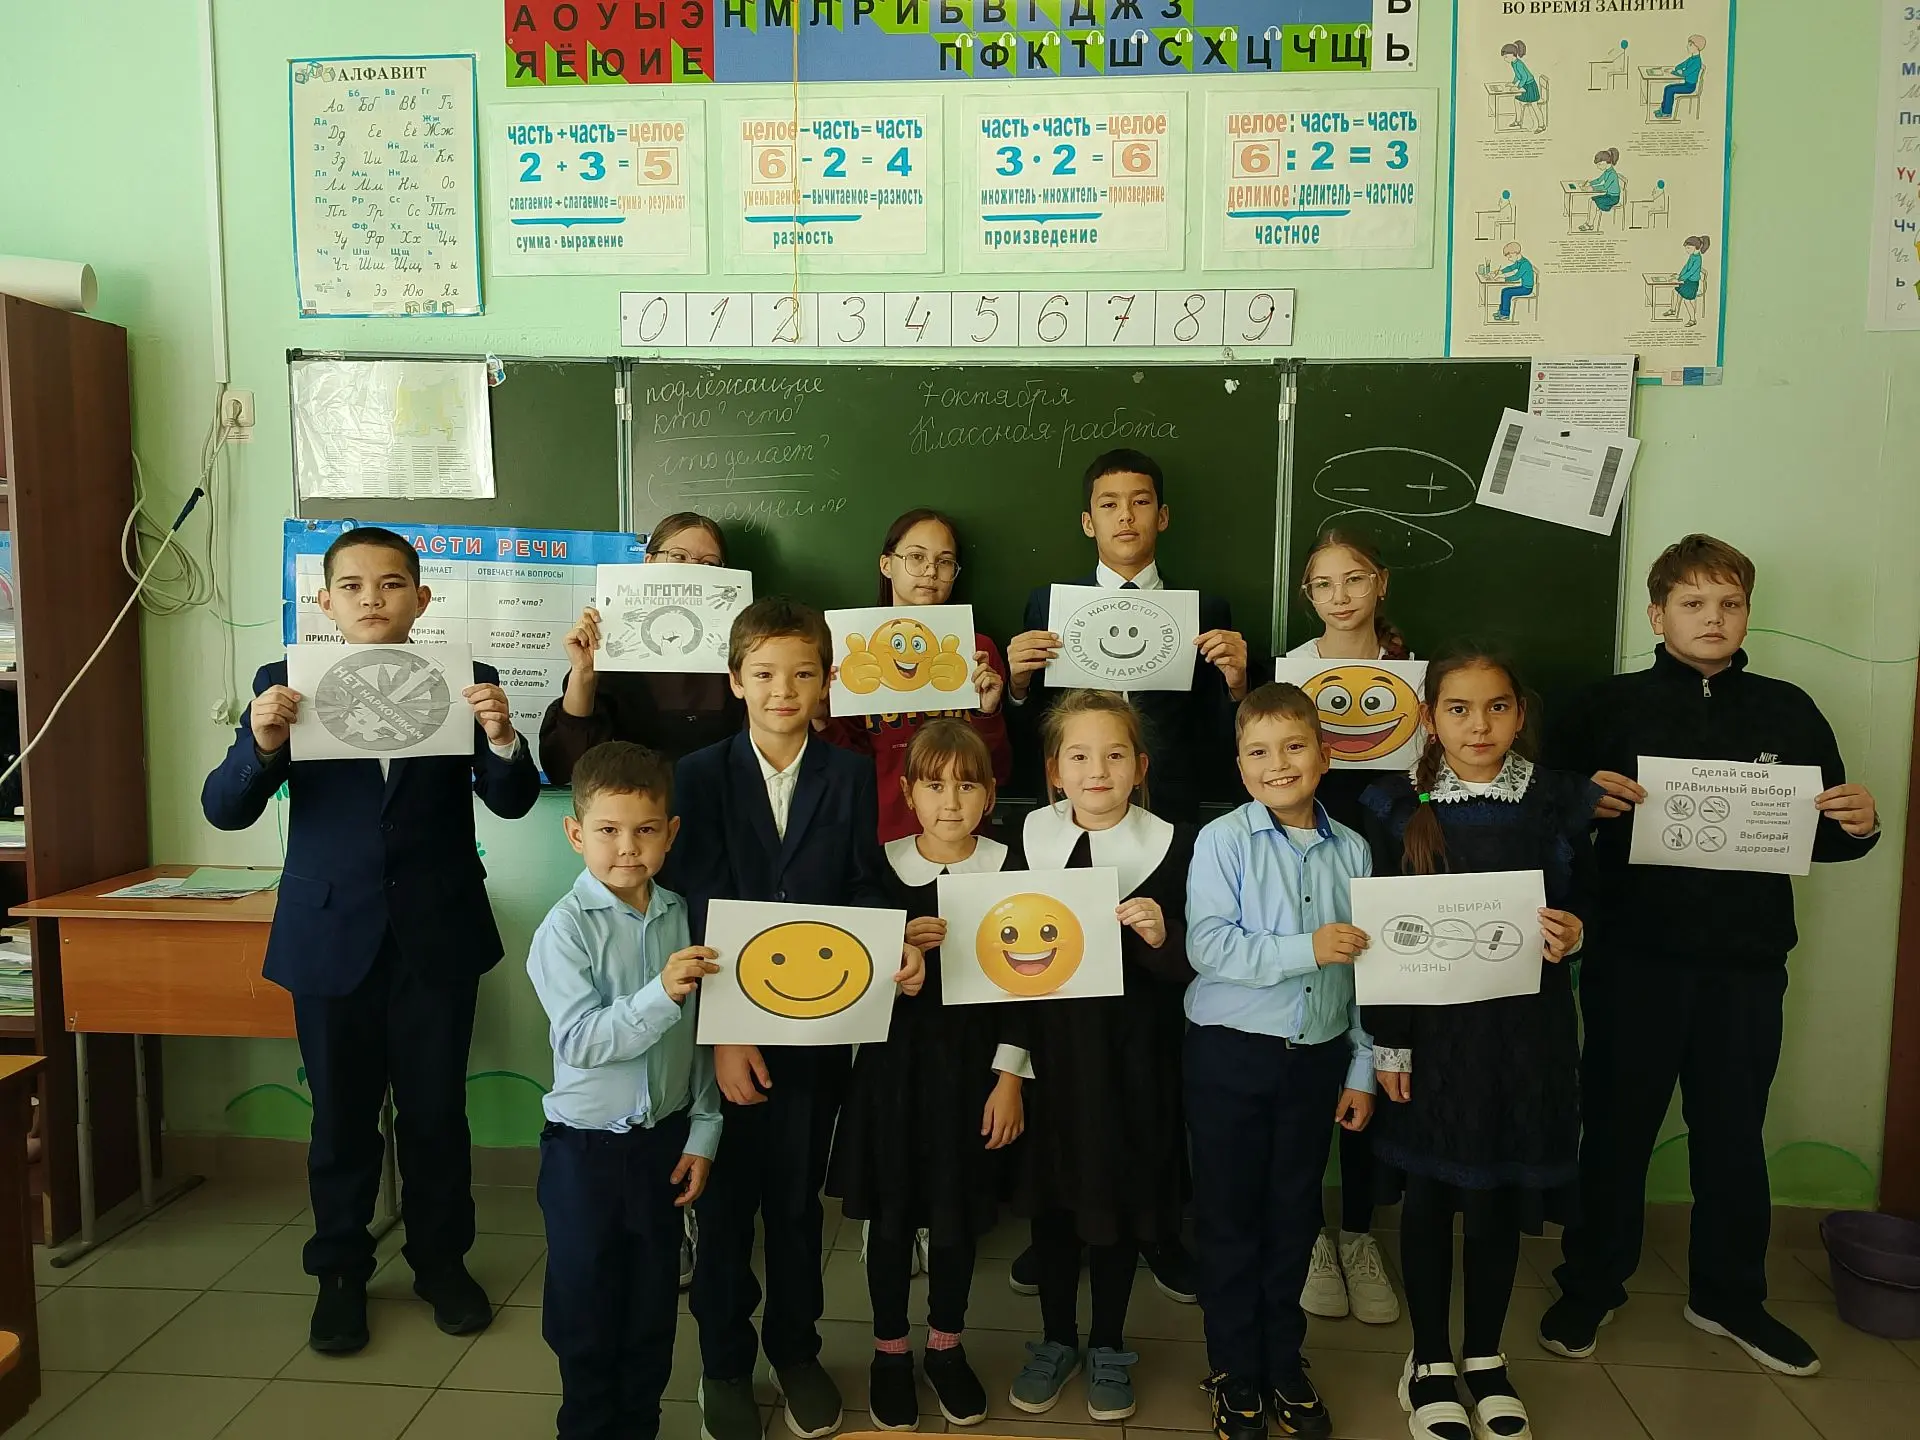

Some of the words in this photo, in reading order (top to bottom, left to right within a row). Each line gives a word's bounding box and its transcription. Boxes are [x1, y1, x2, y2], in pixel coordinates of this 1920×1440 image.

[512, 5, 537, 32] А
[553, 4, 579, 31] О
[597, 3, 619, 30] У
[634, 2, 666, 29] Ы
[681, 1, 704, 28] Э
[724, 0, 747, 27] Н
[1502, 2, 1525, 14] ВО
[1530, 0, 1591, 13] ВРЕМЯ
[514, 51, 537, 78] Я
[556, 43, 577, 77] Ё
[592, 49, 625, 77] Ю
[640, 48, 661, 76] И
[683, 47, 703, 75] Е
[940, 43, 962, 71] П
[980, 41, 1009, 70] Ф
[1027, 41, 1048, 69] К
[1110, 38, 1143, 67] Ш
[1159, 37, 1182, 66] С
[1203, 36, 1227, 65] Х
[1247, 35, 1272, 69] Ц
[1293, 34, 1316, 62] Ч
[1331, 33, 1367, 68] Щ
[1386, 33, 1411, 62] Ь
[338, 67, 427, 81] АЛФАВИТ
[507, 125, 553, 145] часть
[569, 124, 616, 144] часть
[629, 123, 685, 147] целое
[813, 121, 860, 140] часть
[876, 119, 923, 139] часть
[982, 118, 1029, 138] часть
[1043, 117, 1090, 137] часть
[1108, 115, 1167, 140] целое
[1228, 114, 1287, 138] целое
[1300, 112, 1350, 133] часть
[1368, 111, 1418, 132] часть
[519, 152, 542, 182] 2
[579, 151, 606, 181] 3
[643, 151, 673, 180] 5
[758, 149, 786, 178] 6
[823, 147, 846, 177] 2
[886, 147, 912, 177] 4
[995, 146, 1023, 177] 3
[1052, 144, 1076, 175] 2
[1121, 143, 1152, 172] 6
[1240, 144, 1270, 173] 6
[1310, 141, 1334, 170] 2
[1385, 140, 1409, 170] 3
[812, 188, 869, 205] вычитаемое
[877, 189, 923, 210] разность
[981, 188, 1036, 205] множитель
[1042, 186, 1097, 203] множитель
[1227, 184, 1290, 211] делимое
[1299, 184, 1351, 211] делитель
[1366, 183, 1414, 204] частное
[516, 236, 551, 252] сумма
[561, 234, 624, 252] выражение
[773, 231, 834, 249] разность
[984, 228, 1098, 249] произведение
[1255, 225, 1320, 244] частное
[639, 297, 668, 342] 0
[708, 297, 730, 342] 1
[771, 297, 799, 343] 2
[837, 296, 866, 342] 3
[905, 296, 931, 342] 4
[971, 296, 999, 342] 5
[1037, 295, 1069, 342] 6
[1108, 294, 1136, 342] 7
[1173, 294, 1206, 342] 8
[1241, 294, 1275, 341] 9
[919, 381, 939, 407] 7
[941, 379, 1075, 427] октября
[909, 415, 1053, 455] Классная
[1057, 407, 1180, 469] работа
[406, 535, 482, 555] АСТИ
[497, 538, 568, 559] РЕЧИ
[477, 568, 513, 577] ОТВЕЧАЕТ
[515, 569, 526, 578] НА
[528, 570, 564, 579] ВОПРОСЫ
[643, 583, 703, 597] ПРОТИВ
[498, 598, 520, 606] кто?
[521, 598, 544, 607] что?
[624, 597, 703, 606] НАРКОТИКОВ
[1069, 630, 1100, 671] ПРОТИВ
[332, 665, 365, 690] НЕТ
[359, 688, 425, 741] НАРКОТИКАМ
[1758, 751, 1779, 763] NIKE
[1691, 767, 1737, 778] Сделай
[1740, 769, 1769, 779] свой
[1665, 781, 1747, 794] ПРАВильный
[1751, 785, 1797, 798] выбор!
[1739, 831, 1789, 842] Выбирай
[1437, 899, 1502, 913] ВЫБИРАЙ
